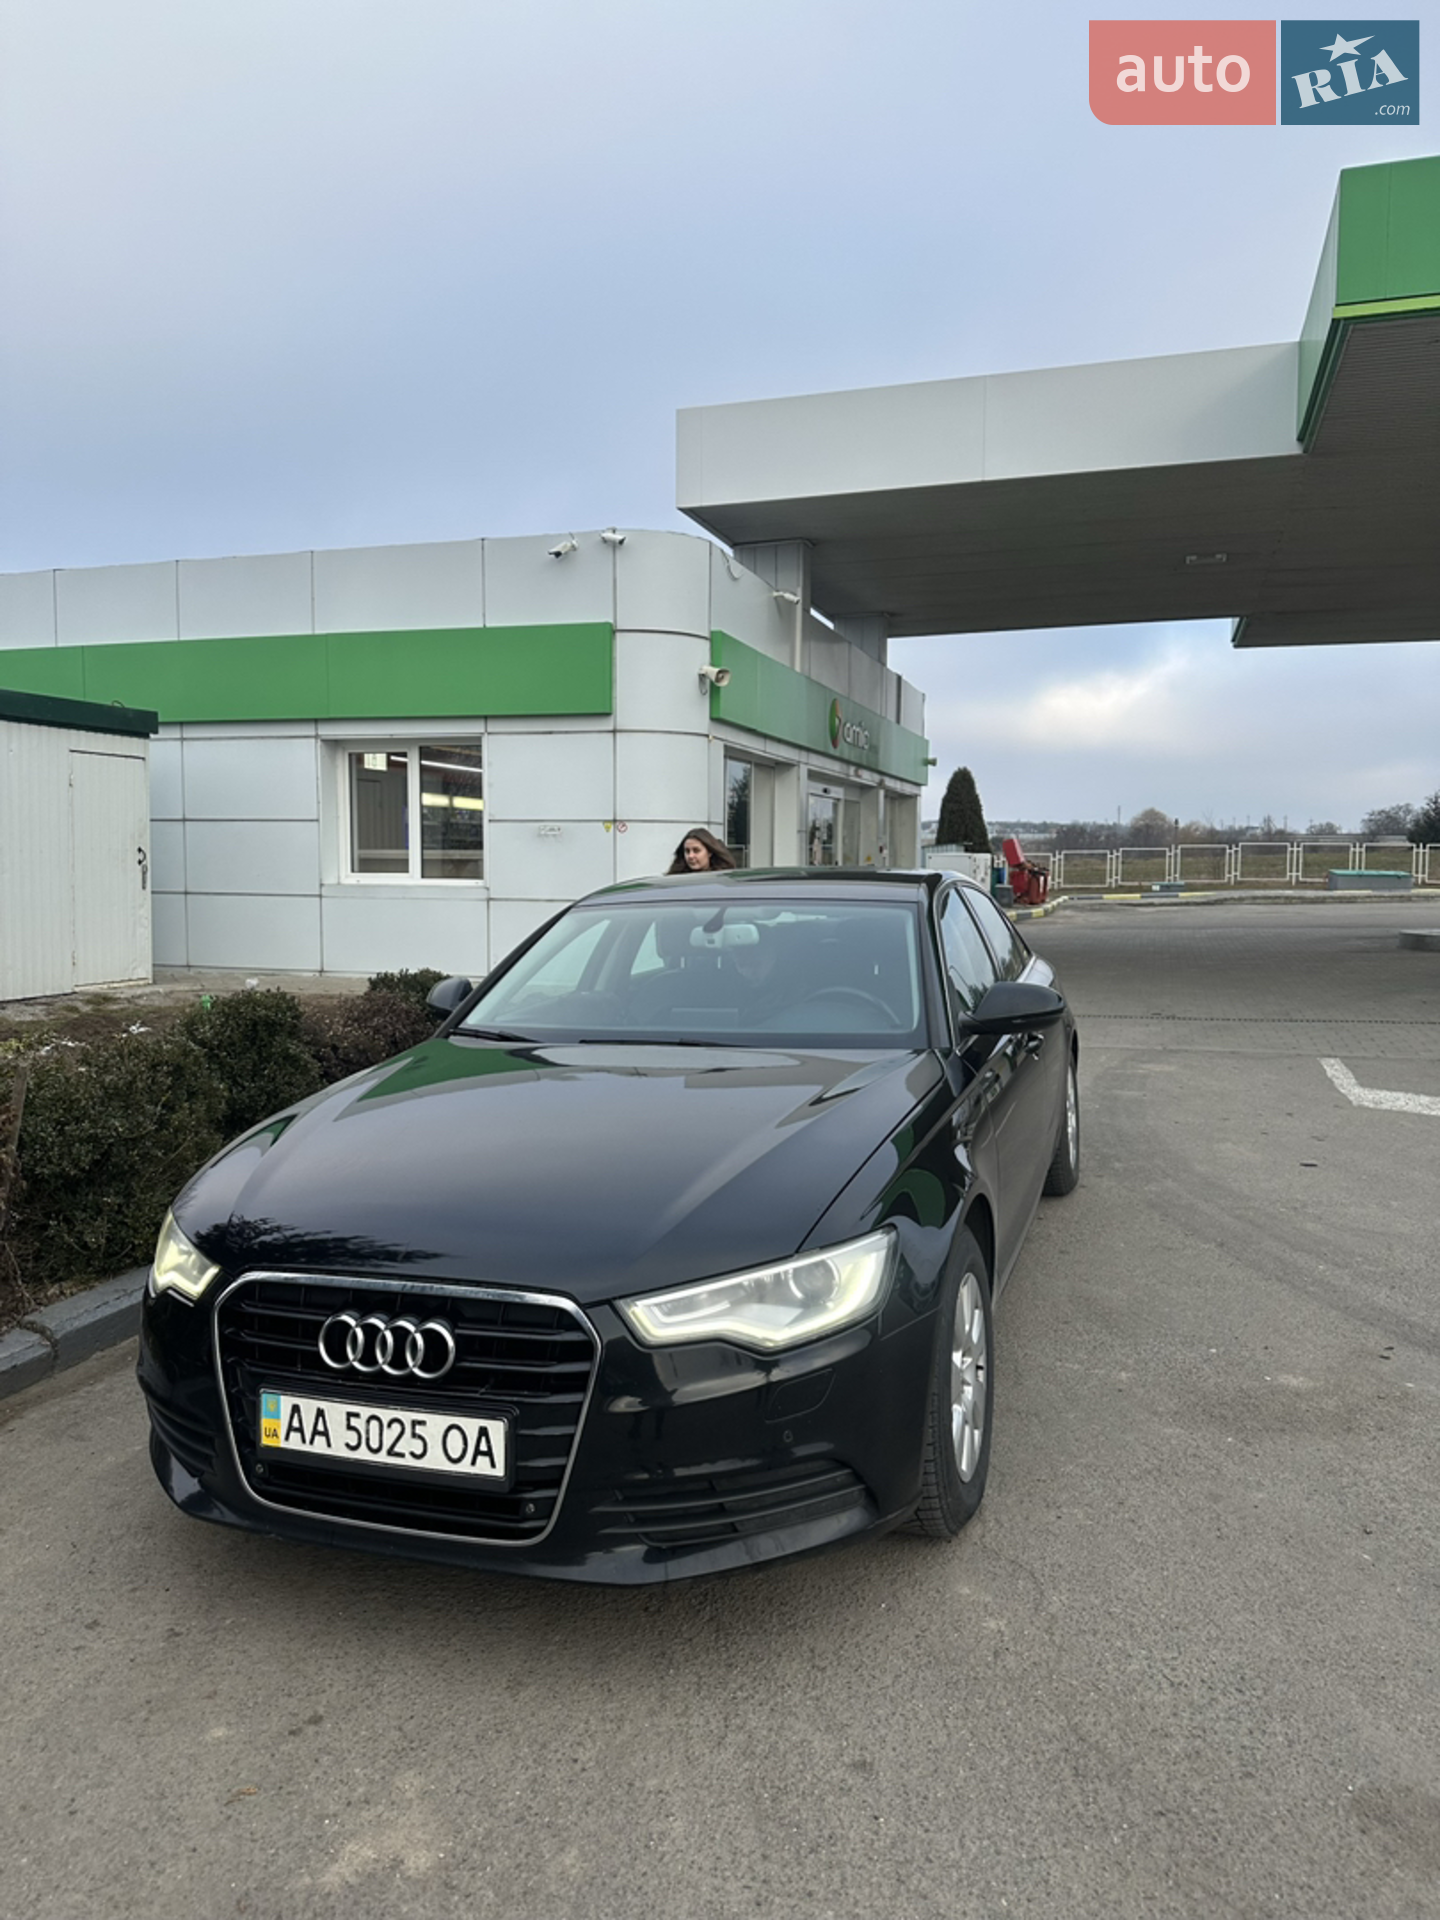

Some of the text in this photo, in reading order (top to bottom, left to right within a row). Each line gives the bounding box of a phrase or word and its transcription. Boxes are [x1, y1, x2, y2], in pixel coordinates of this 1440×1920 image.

[264, 1427, 279, 1440] UA
[284, 1403, 497, 1469] AA 5025 OA
